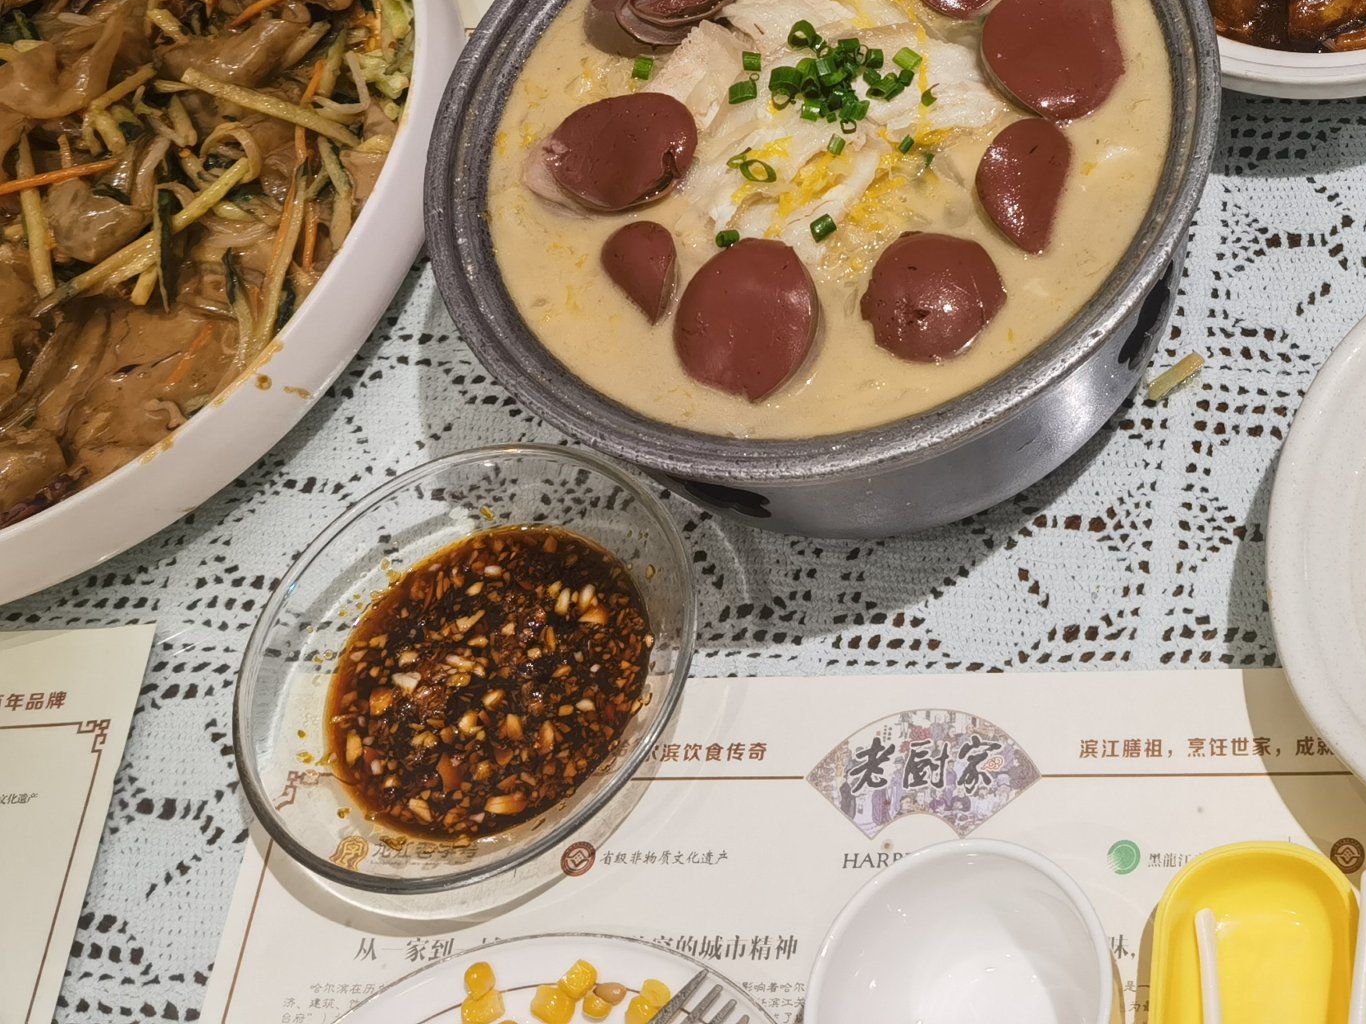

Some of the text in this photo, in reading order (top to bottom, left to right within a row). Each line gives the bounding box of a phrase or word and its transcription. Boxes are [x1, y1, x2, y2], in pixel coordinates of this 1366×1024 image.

[0, 691, 66, 712] 年品牌
[849, 736, 1001, 794] 老厨家
[600, 849, 729, 866] 省级非物质文化遗产
